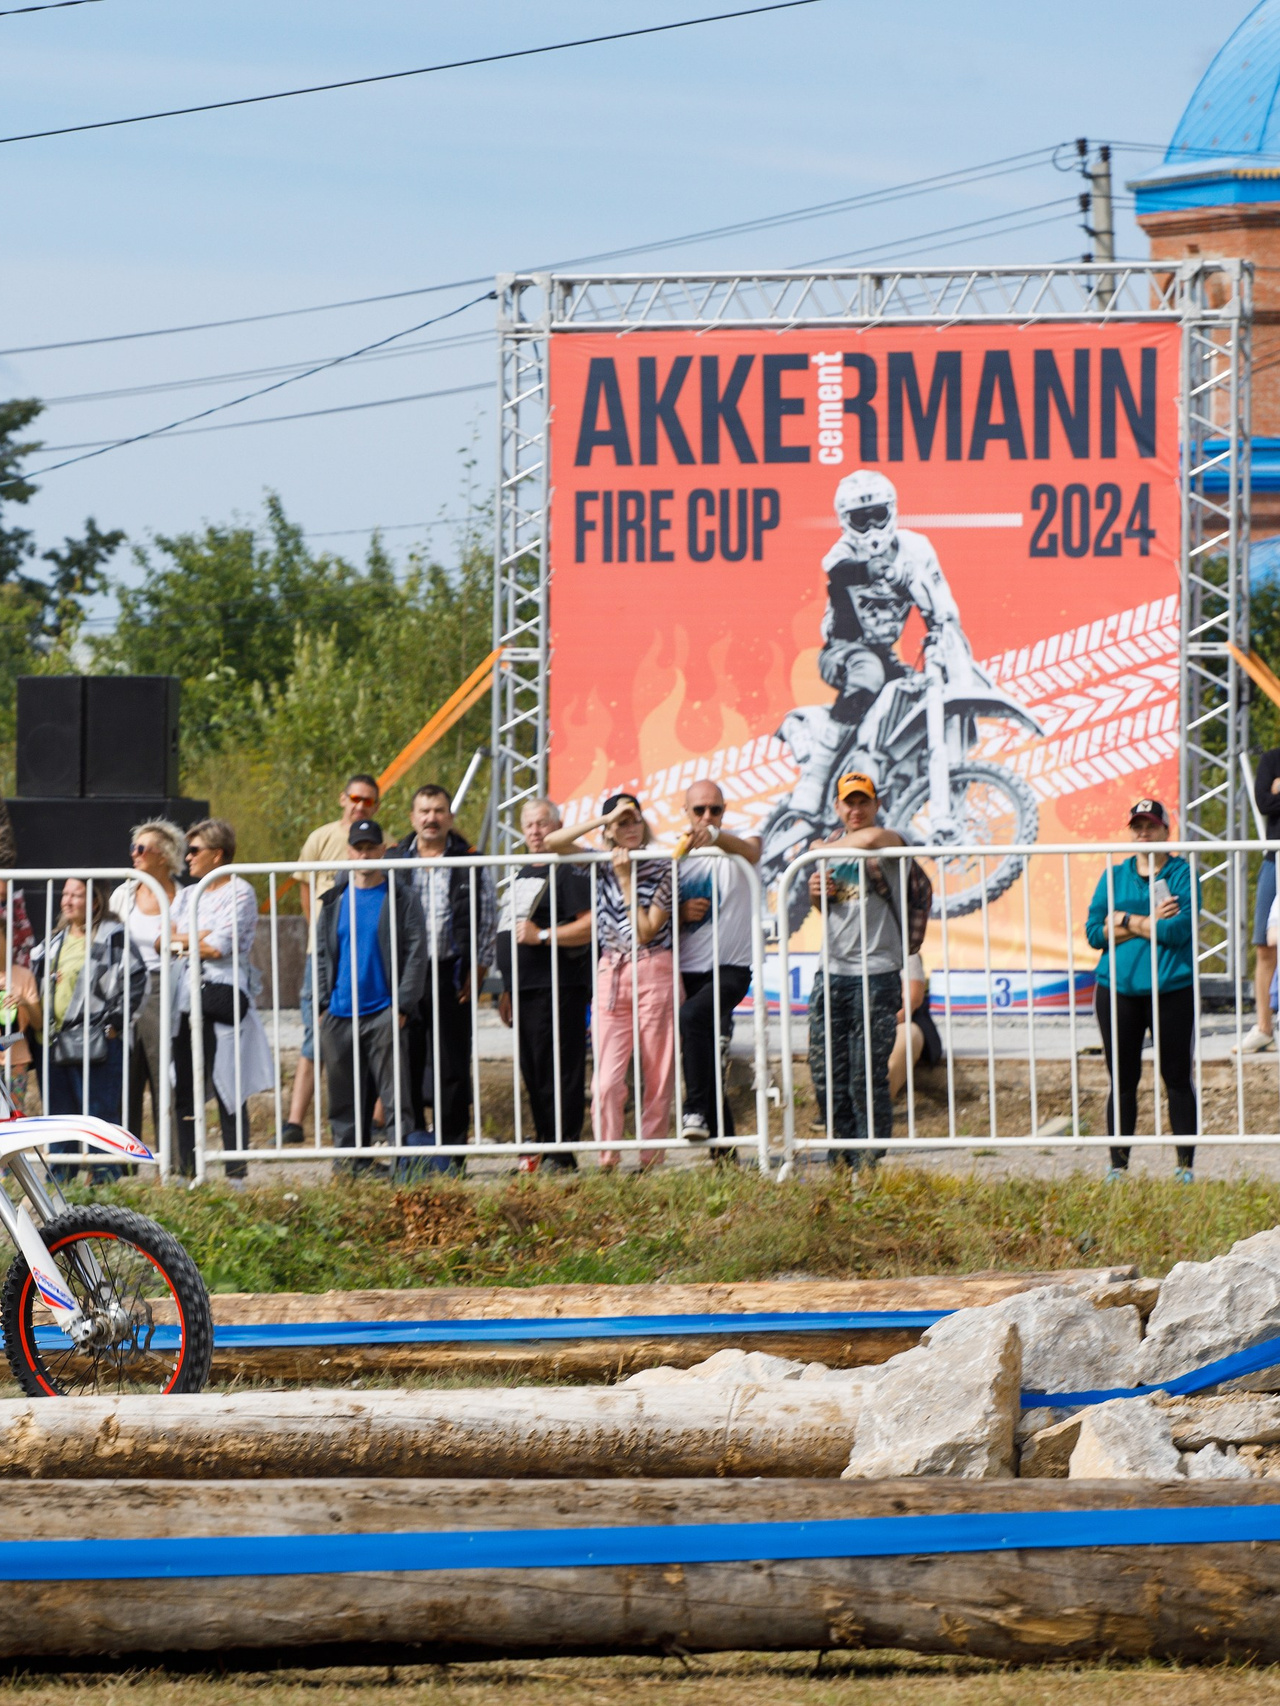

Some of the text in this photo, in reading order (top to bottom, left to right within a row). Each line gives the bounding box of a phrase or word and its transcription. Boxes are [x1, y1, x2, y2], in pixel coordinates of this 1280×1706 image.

[574, 347, 1157, 466] AKKERMANN
[810, 351, 843, 465] cement
[575, 482, 1156, 563] FIRE CUP 2024
[995, 978, 1011, 1007] 3
